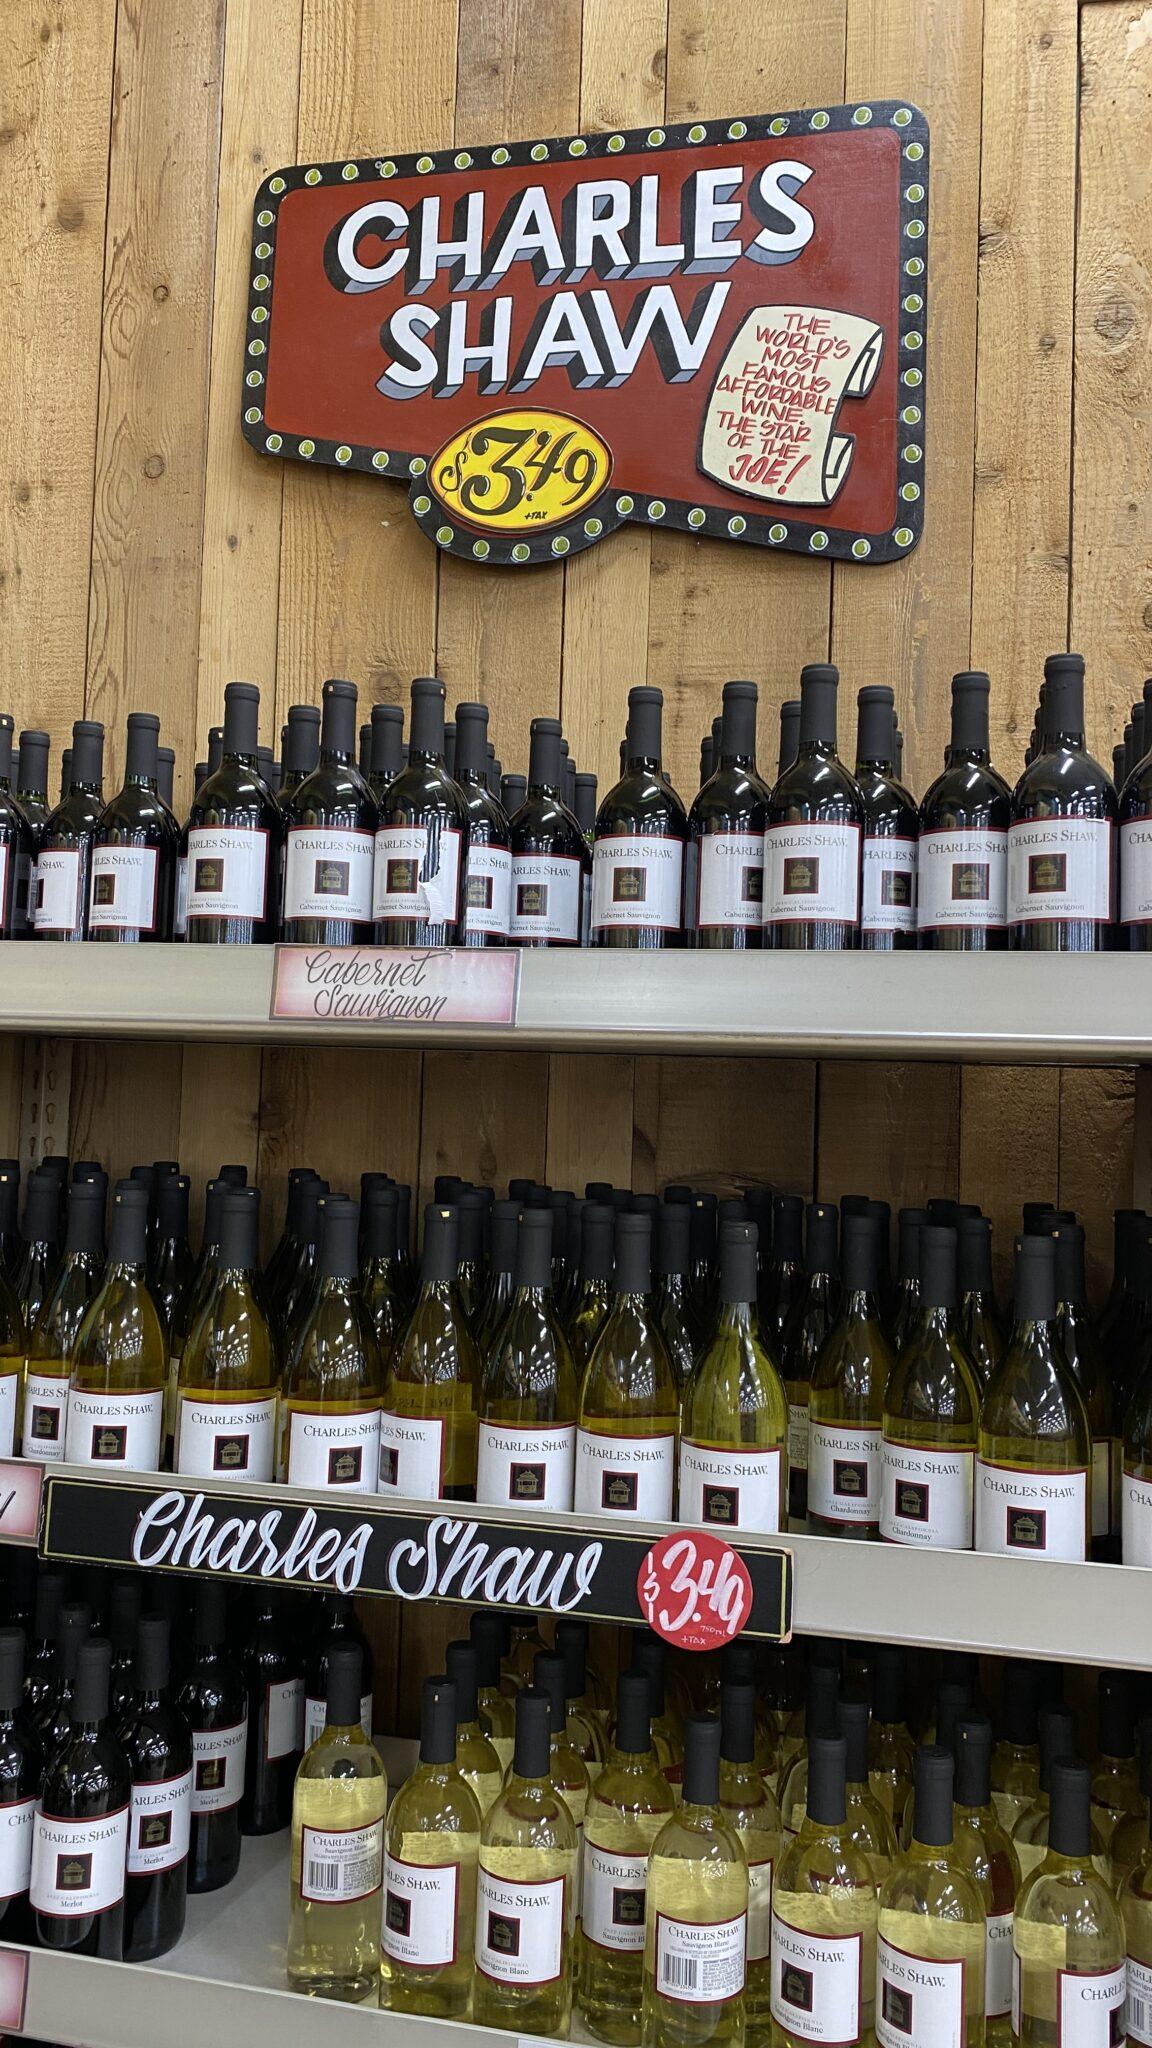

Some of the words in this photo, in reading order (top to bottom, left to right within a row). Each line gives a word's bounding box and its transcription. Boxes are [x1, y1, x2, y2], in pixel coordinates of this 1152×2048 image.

[332, 159, 817, 291] CHARLES
[784, 313, 831, 335] THE
[383, 280, 732, 389] SHAW
[756, 325, 851, 359] WORLD'S
[761, 347, 828, 373] MOST
[742, 362, 831, 393] FAMOUS
[716, 374, 838, 414] AFFORDABLE
[741, 397, 805, 425] WINE.
[717, 410, 756, 433] THE
[759, 421, 811, 442] STAR
[727, 433, 754, 448] OF
[761, 439, 800, 458] THE
[729, 454, 811, 495] JOE!
[524, 510, 549, 521] +TAX
[294, 839, 343, 851] CHARLES
[767, 836, 812, 850] CHARLES
[1010, 832, 1058, 847] CHARLES
[597, 847, 640, 859] CHARLES
[715, 844, 763, 856] CHARLE
[864, 850, 907, 860] HARLES
[928, 843, 982, 855] CHARLES
[511, 866, 541, 875] ARLES
[935, 911, 967, 919] Cabernet
[969, 911, 1004, 919] Sauvignon
[1044, 904, 1084, 912] Sauvignon
[306, 949, 453, 986] Cabernet
[313, 985, 448, 1021] Sauvignon
[74, 1401, 120, 1415] CHARLES
[191, 1412, 243, 1425] CHARLES
[303, 1424, 357, 1437] CHARLES
[487, 1436, 539, 1452] CHARLES
[814, 1433, 860, 1451] CHARLES
[582, 1443, 631, 1461] CHARLES
[684, 1455, 731, 1475] CHARLES
[983, 1476, 1038, 1498] CHARLES
[830, 1505, 871, 1516] Chardonnay
[892, 1526, 932, 1541] Chardonnay
[133, 1490, 374, 1593] Charles
[389, 1515, 603, 1612] Shaw
[132, 1795, 166, 1806] ARLES
[39, 1827, 86, 1844] CHARLES
[313, 1836, 355, 1846] CHARLES
[144, 1856, 164, 1865] Merlot
[591, 1858, 641, 1878] CHARLES
[602, 1930, 638, 1944] Sauvignon
[668, 1926, 715, 1940] CHARLES
[401, 1945, 419, 1957] Blanc
[509, 1966, 529, 1975] Blanc
[803, 2021, 824, 2034] Blanc
